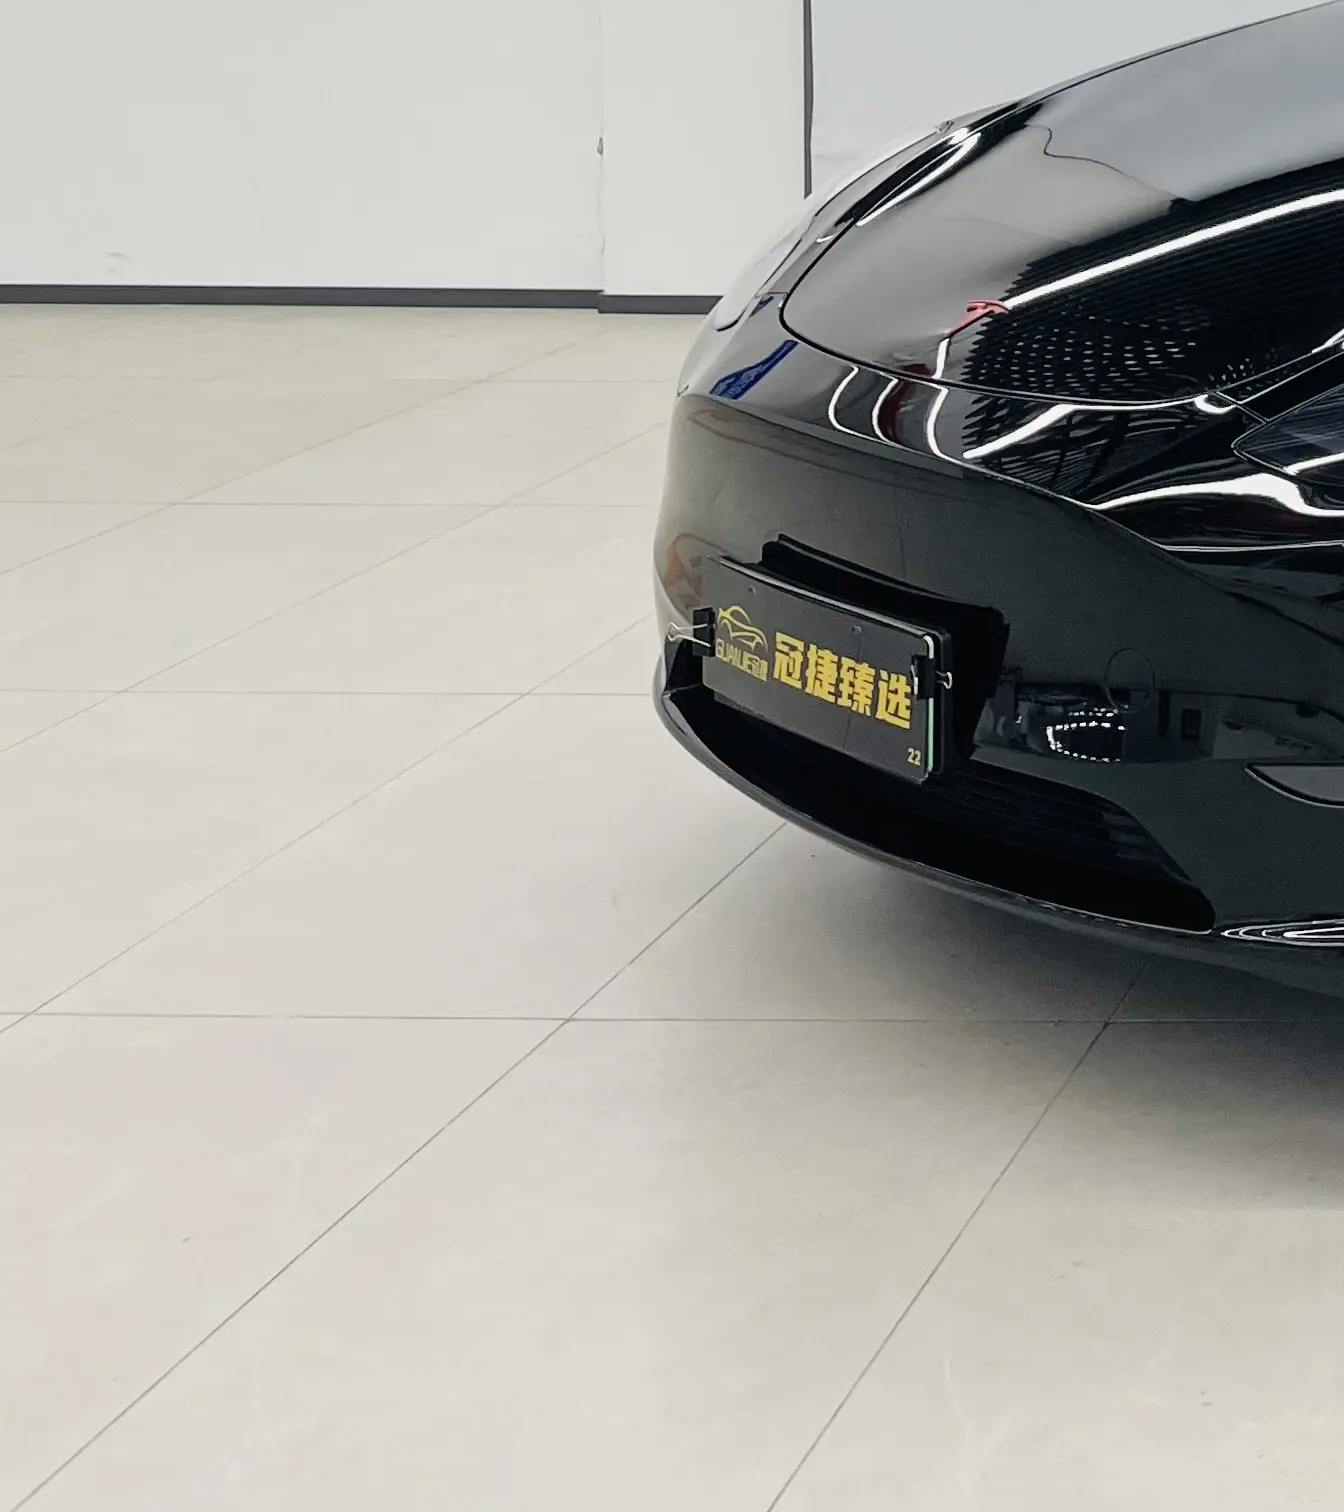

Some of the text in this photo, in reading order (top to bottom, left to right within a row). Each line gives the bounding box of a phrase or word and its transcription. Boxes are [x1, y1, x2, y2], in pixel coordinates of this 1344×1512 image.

[773, 632, 912, 729] 冠捷臻选
[907, 747, 921, 766] 22
